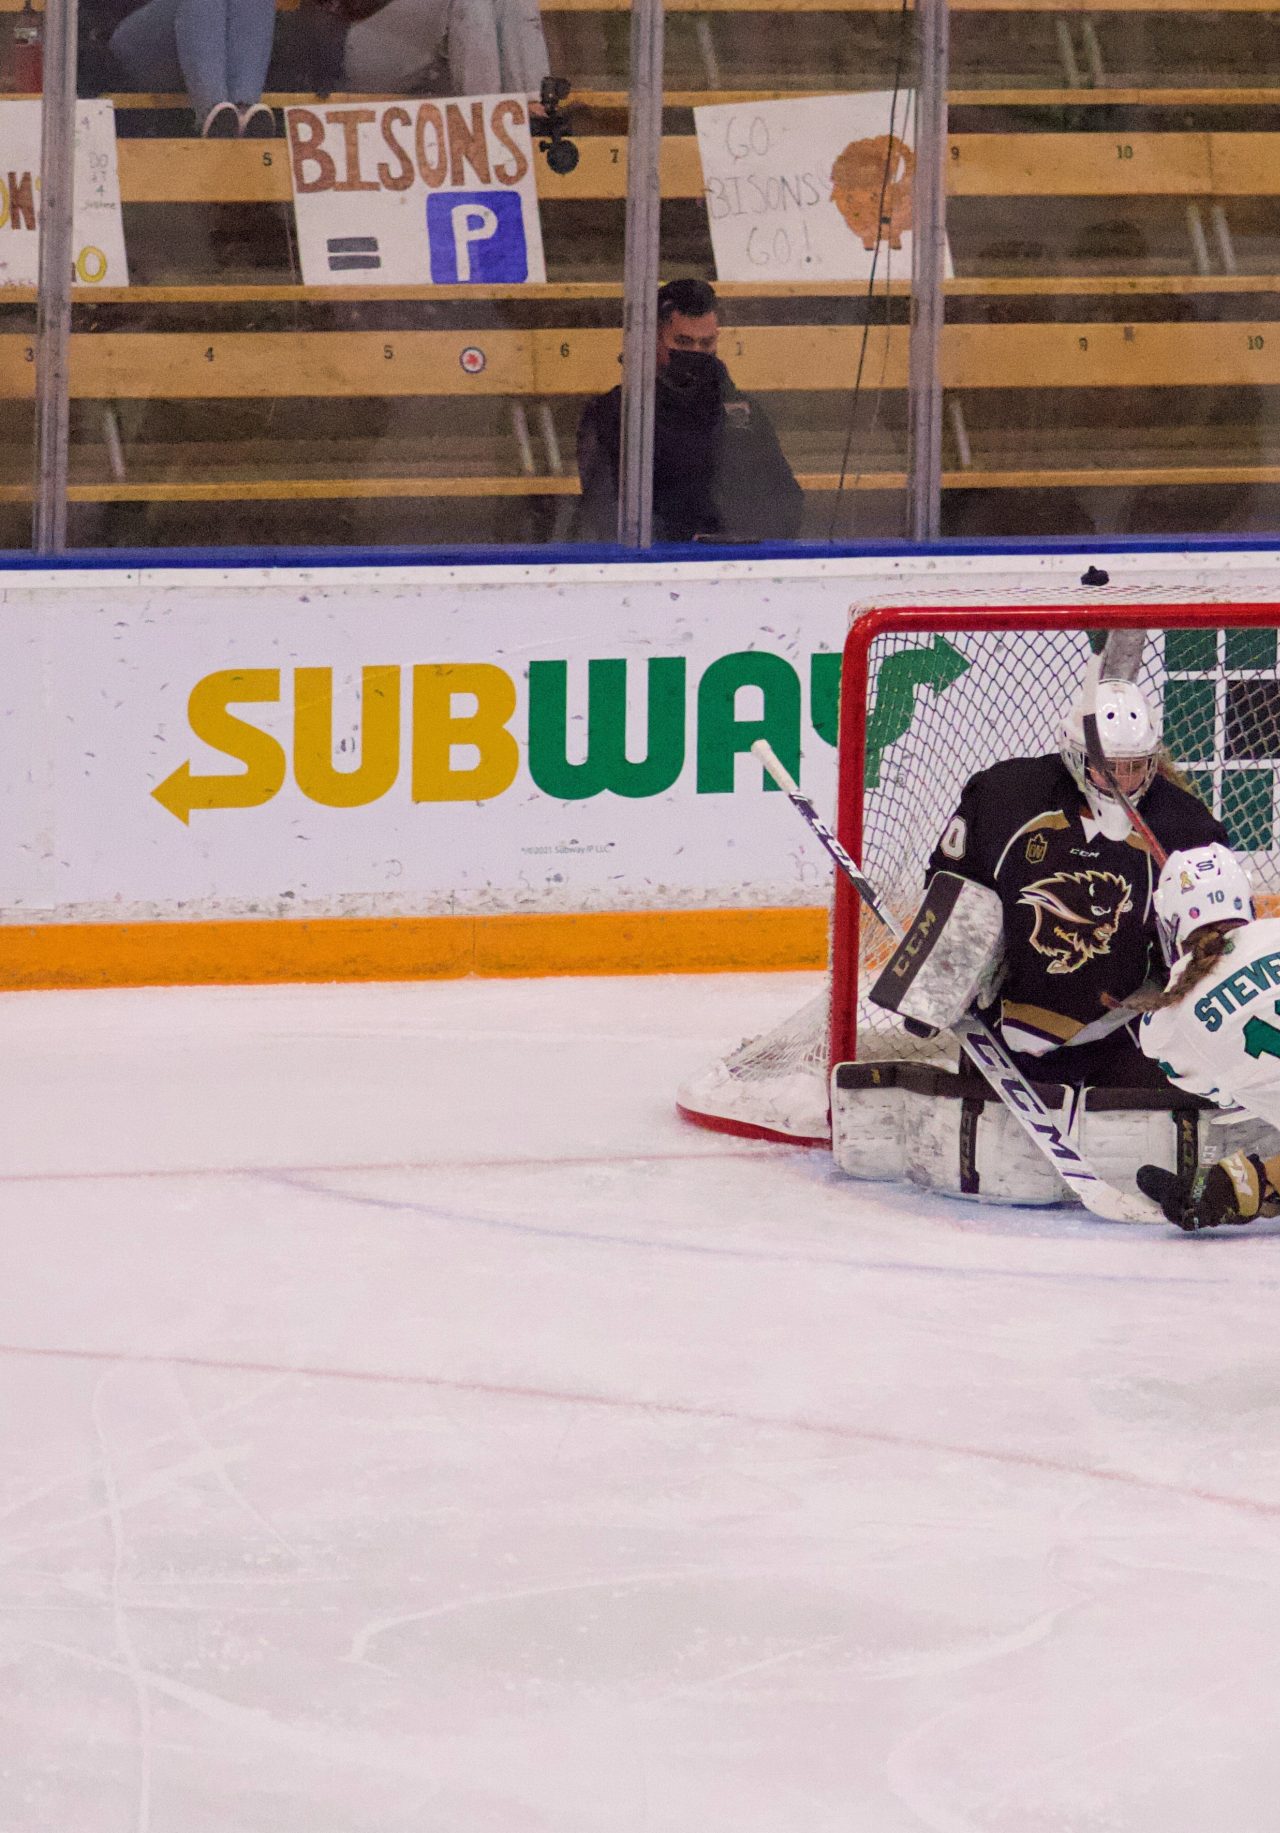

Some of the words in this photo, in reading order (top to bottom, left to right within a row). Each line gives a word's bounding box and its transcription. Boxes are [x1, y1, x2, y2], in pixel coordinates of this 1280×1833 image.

[287, 101, 528, 194] BISONS
[727, 116, 769, 159] GO
[706, 173, 820, 219] BISONS
[205, 346, 216, 361] 4
[384, 344, 394, 359] 5
[560, 343, 570, 358] 6
[150, 640, 972, 828] SUBWAY
[1069, 848, 1100, 858] CCM
[1206, 890, 1224, 904] 10
[893, 908, 937, 977] CCM
[966, 1032, 1083, 1162] CCM
